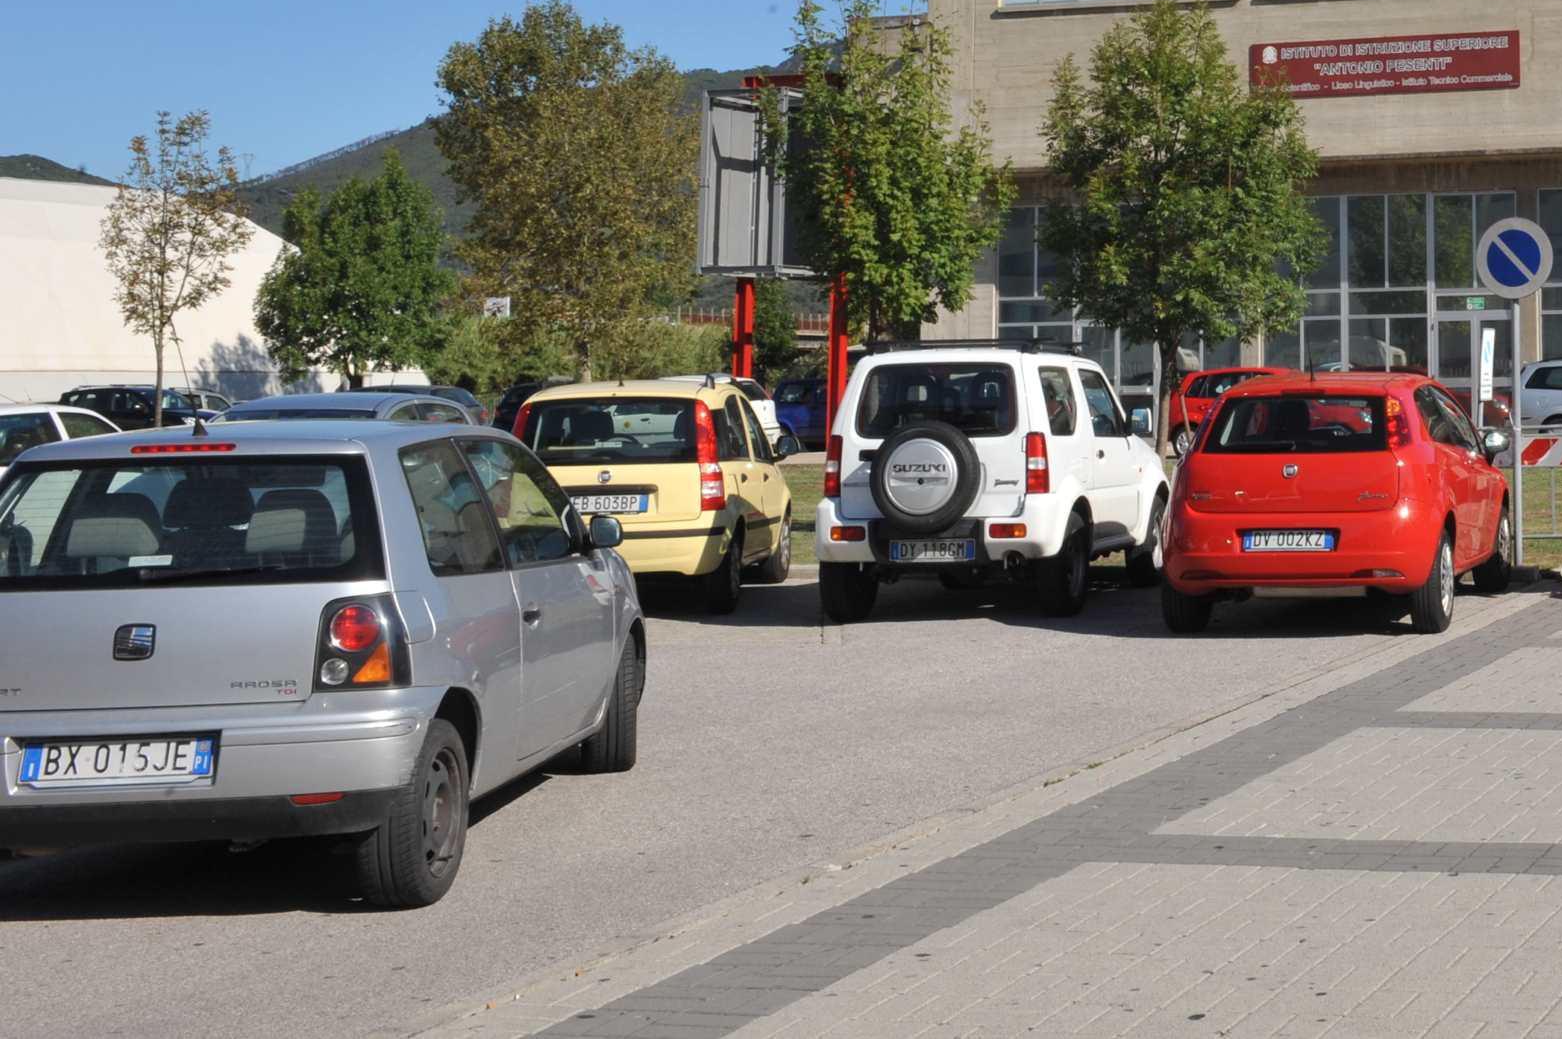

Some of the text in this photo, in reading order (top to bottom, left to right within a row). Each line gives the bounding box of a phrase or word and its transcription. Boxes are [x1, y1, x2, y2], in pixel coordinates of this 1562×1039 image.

[1281, 36, 1509, 59] ISTITUTO DI ISTRUZIONE SUPERIORE
[892, 463, 946, 473] SUZUKI
[1253, 531, 1324, 547] DV 002KZ
[230, 679, 297, 689] AROSA
[44, 744, 83, 776] BX
[93, 740, 190, 773] 015JE
